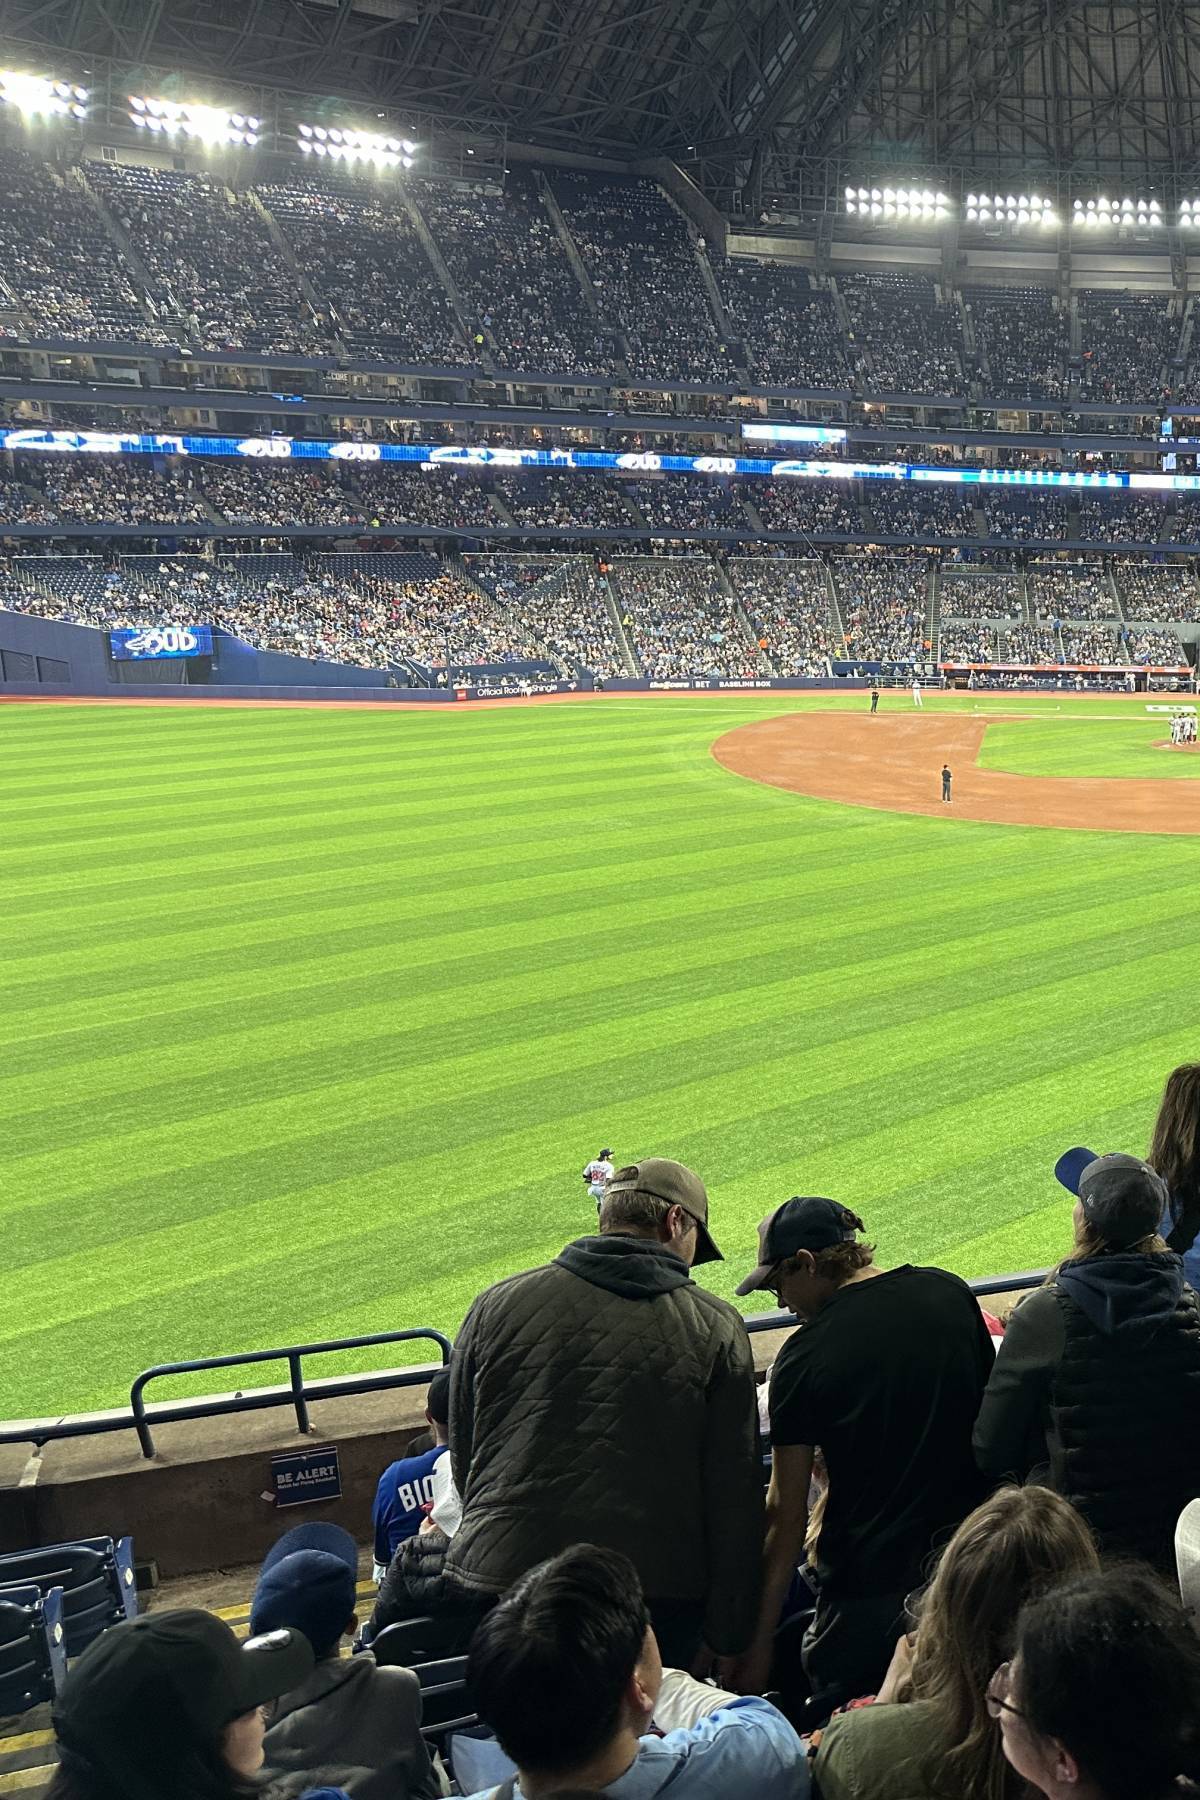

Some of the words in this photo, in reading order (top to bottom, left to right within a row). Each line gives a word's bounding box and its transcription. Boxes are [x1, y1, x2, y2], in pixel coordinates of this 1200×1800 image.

[477, 686, 503, 697] Official
[276, 1472, 293, 1484] BE
[296, 1465, 336, 1481] ALERT
